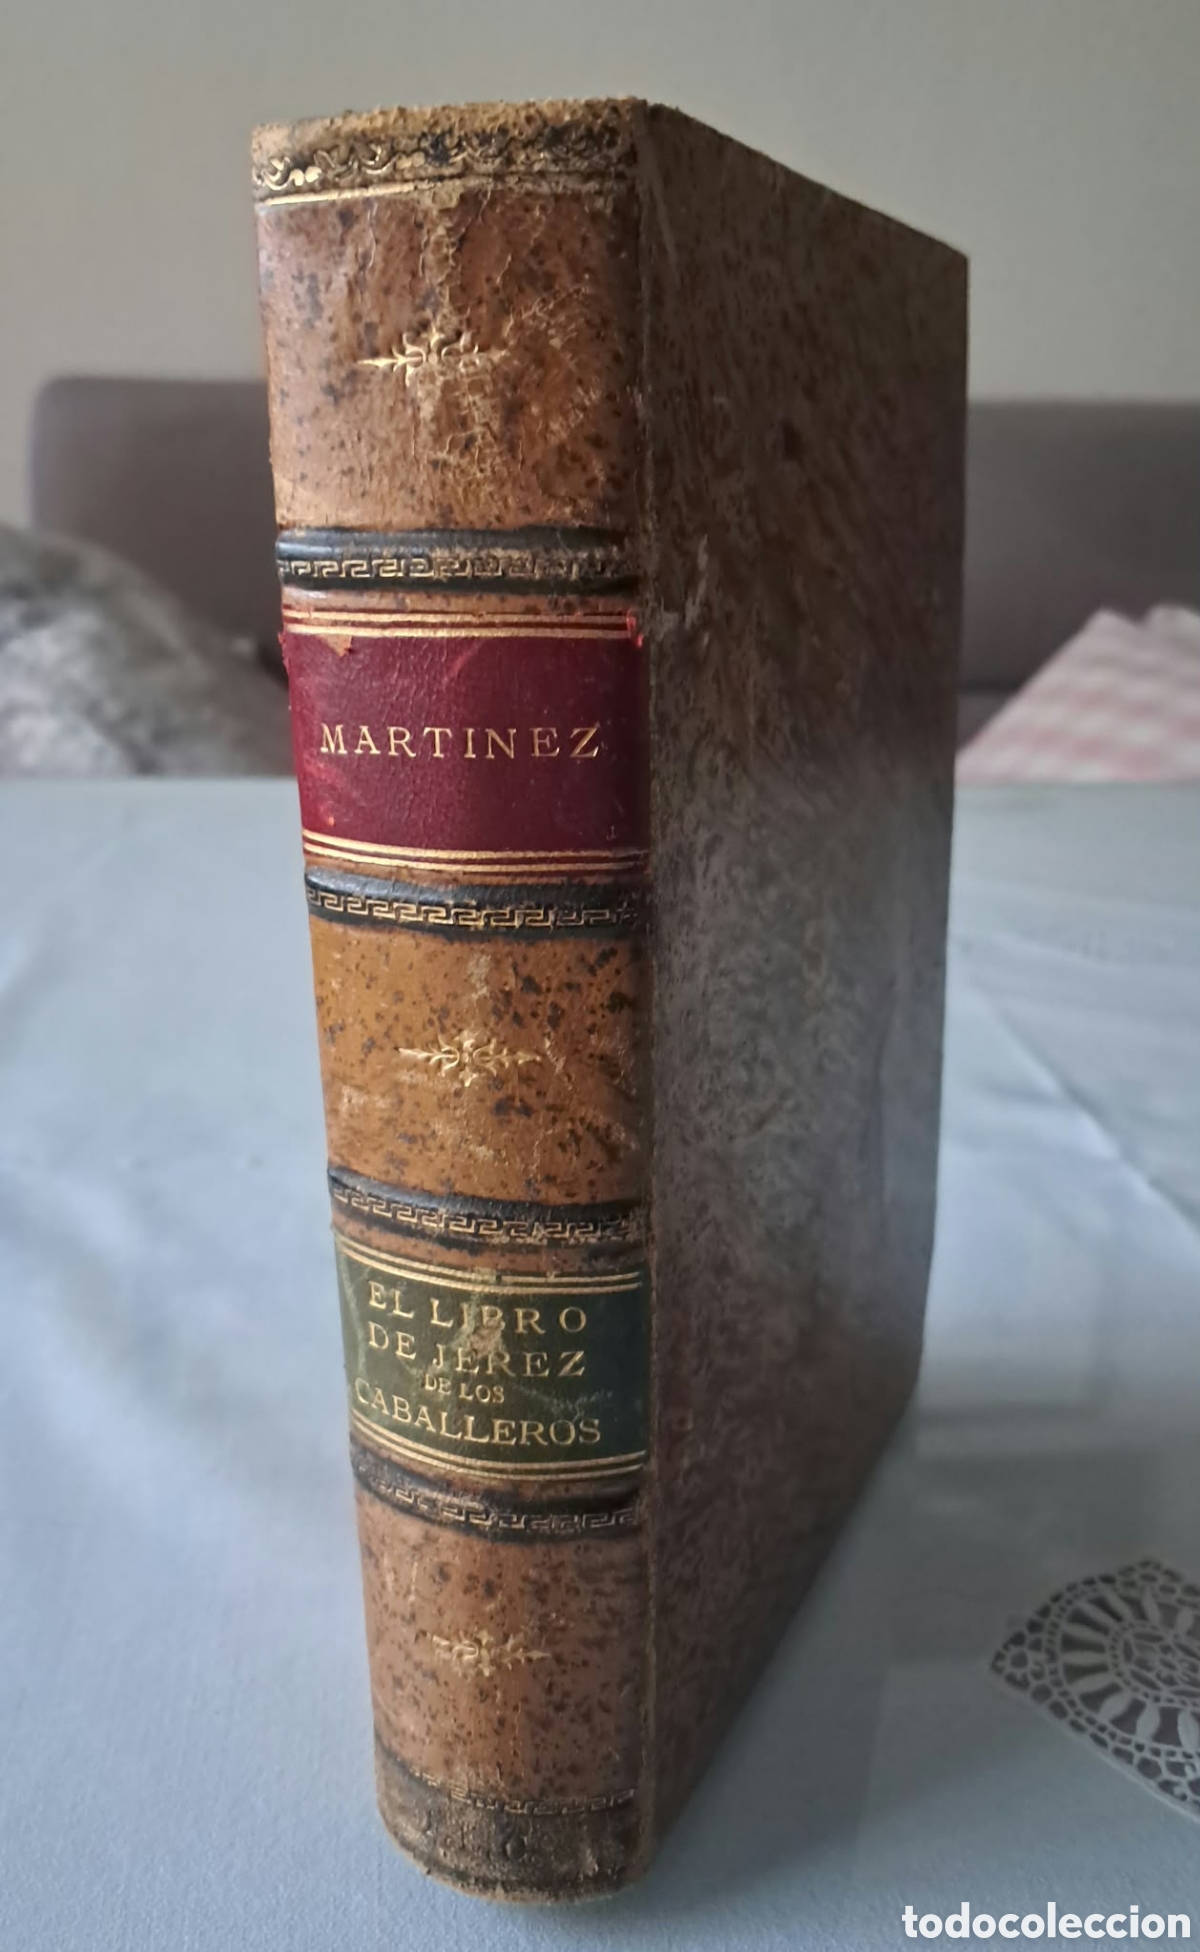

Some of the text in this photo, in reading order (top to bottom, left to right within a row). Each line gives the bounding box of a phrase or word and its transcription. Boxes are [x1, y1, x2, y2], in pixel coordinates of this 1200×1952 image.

[320, 722, 600, 759] MARTINEZ
[368, 1281, 588, 1335] EL LIBRO
[367, 1320, 586, 1378] DE JEREZ
[354, 1377, 601, 1446] CABALLEROS
[424, 1372, 506, 1404] DE LOS
